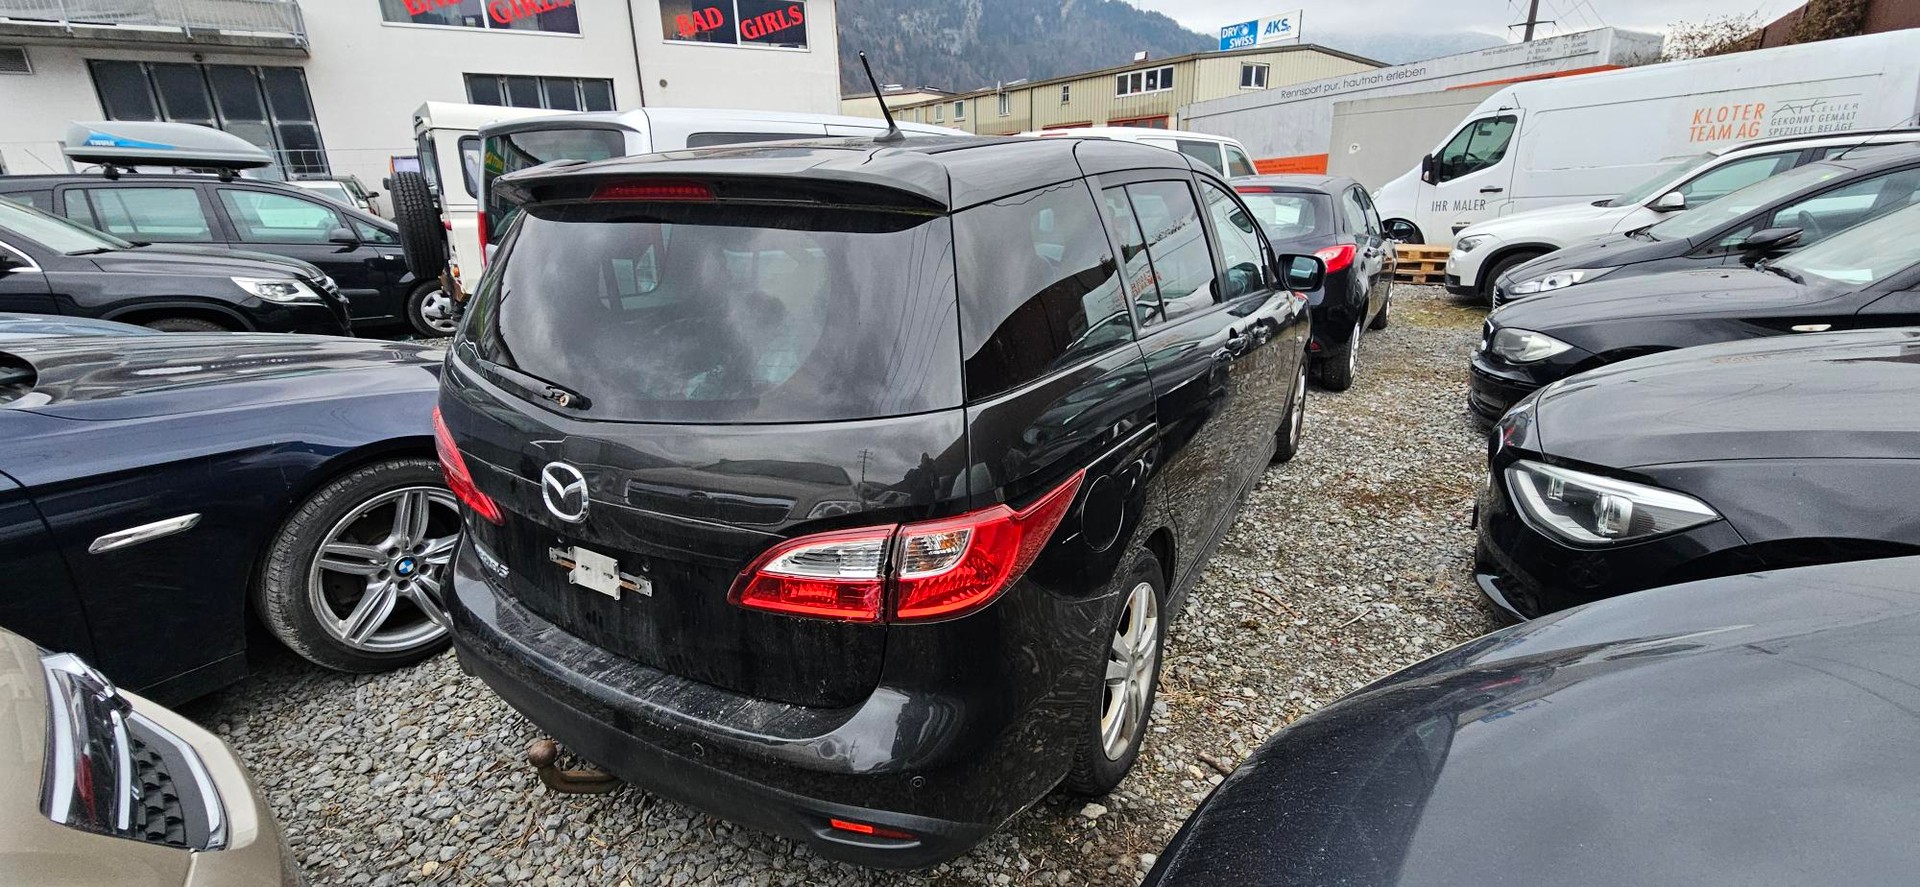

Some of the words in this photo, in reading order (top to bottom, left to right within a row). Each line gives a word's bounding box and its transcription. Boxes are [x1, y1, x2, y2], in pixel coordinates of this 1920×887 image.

[488, 0, 574, 24] GIRL
[676, 7, 724, 37] BAD
[740, 5, 803, 39] GIRLS
[1222, 26, 1239, 39] DRY
[1229, 34, 1255, 49] SWISS
[1280, 83, 1322, 99] Rennsport
[1343, 73, 1383, 88] hautnah
[1386, 66, 1426, 81] erleben
[1692, 102, 1766, 125] KLOTER
[1770, 114, 1815, 126] GEKONNT
[1818, 111, 1857, 123] GEMALT
[1689, 123, 1732, 143] TEAM
[1735, 121, 1761, 139] AG
[1768, 124, 1814, 137] SPEZIELLE
[1431, 200, 1448, 212] IHR
[1452, 199, 1486, 212] MALER
